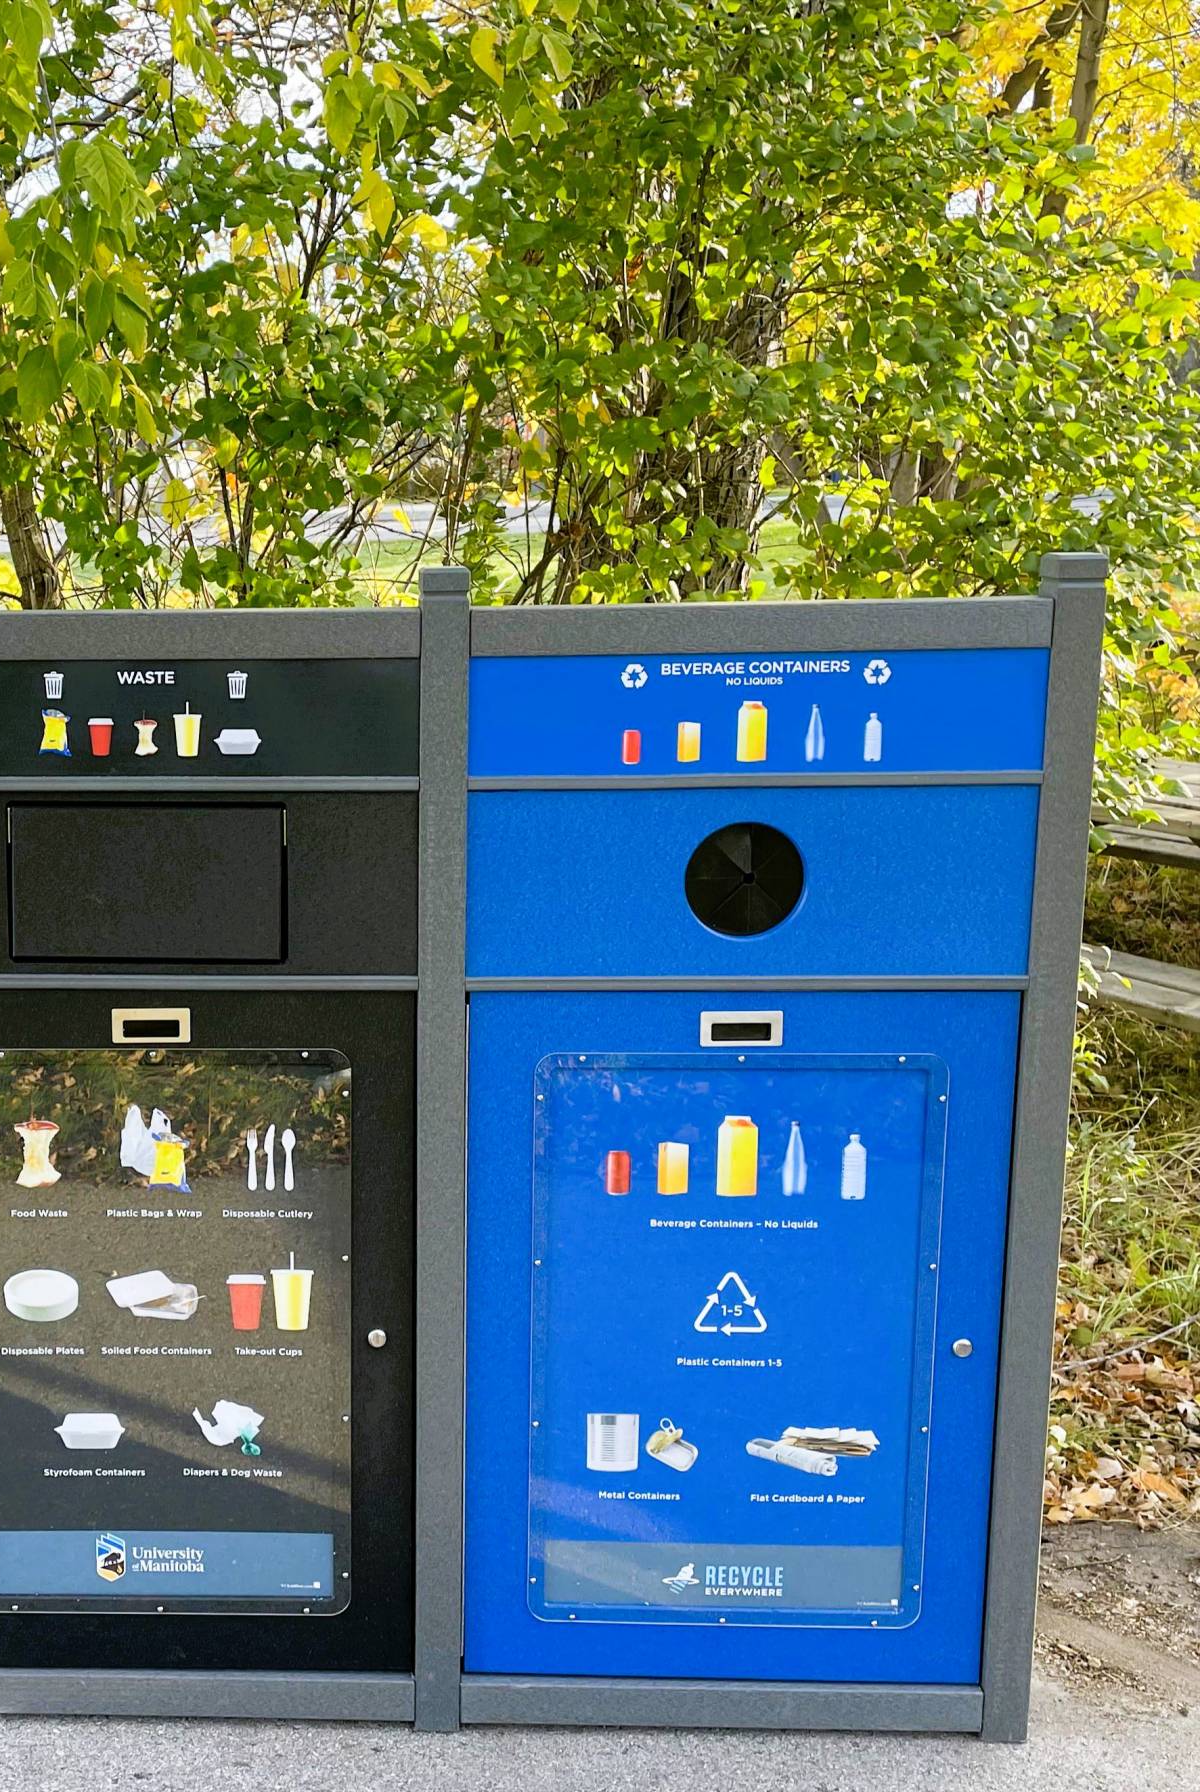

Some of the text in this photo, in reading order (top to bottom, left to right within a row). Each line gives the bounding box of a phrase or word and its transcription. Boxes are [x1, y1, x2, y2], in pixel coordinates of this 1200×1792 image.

[660, 659, 851, 677] BEVERAGE CONTAINERS
[116, 670, 175, 685] WASTE
[725, 676, 784, 687] NO LIQUIDS
[10, 1208, 68, 1218] Food Waste
[106, 1208, 203, 1220] Plastic Bags & Wrap
[222, 1208, 314, 1220] Disposable Cutlery
[649, 1218, 697, 1229] Beverage
[699, 1219, 754, 1229] Containers
[764, 1219, 779, 1229] No
[781, 1219, 819, 1231] Liquids
[720, 1304, 744, 1318] 1-5
[1, 1346, 85, 1357] Disposable Plates
[101, 1346, 212, 1356] Soiled Food Containers
[234, 1346, 303, 1358] Take-out Cups
[676, 1357, 783, 1368] Plastic Containers 1-5
[43, 1467, 146, 1478] Styrofoam Containers
[183, 1467, 283, 1479] Diapers & Dog Waste
[598, 1490, 681, 1501] Metal Containers
[750, 1493, 866, 1505] Flat Cardboard & Paper
[131, 1546, 204, 1562] University
[140, 1559, 205, 1573] Manitoba
[704, 1565, 784, 1587] RECYCLE
[704, 1586, 784, 1597] EVERYWHERE
